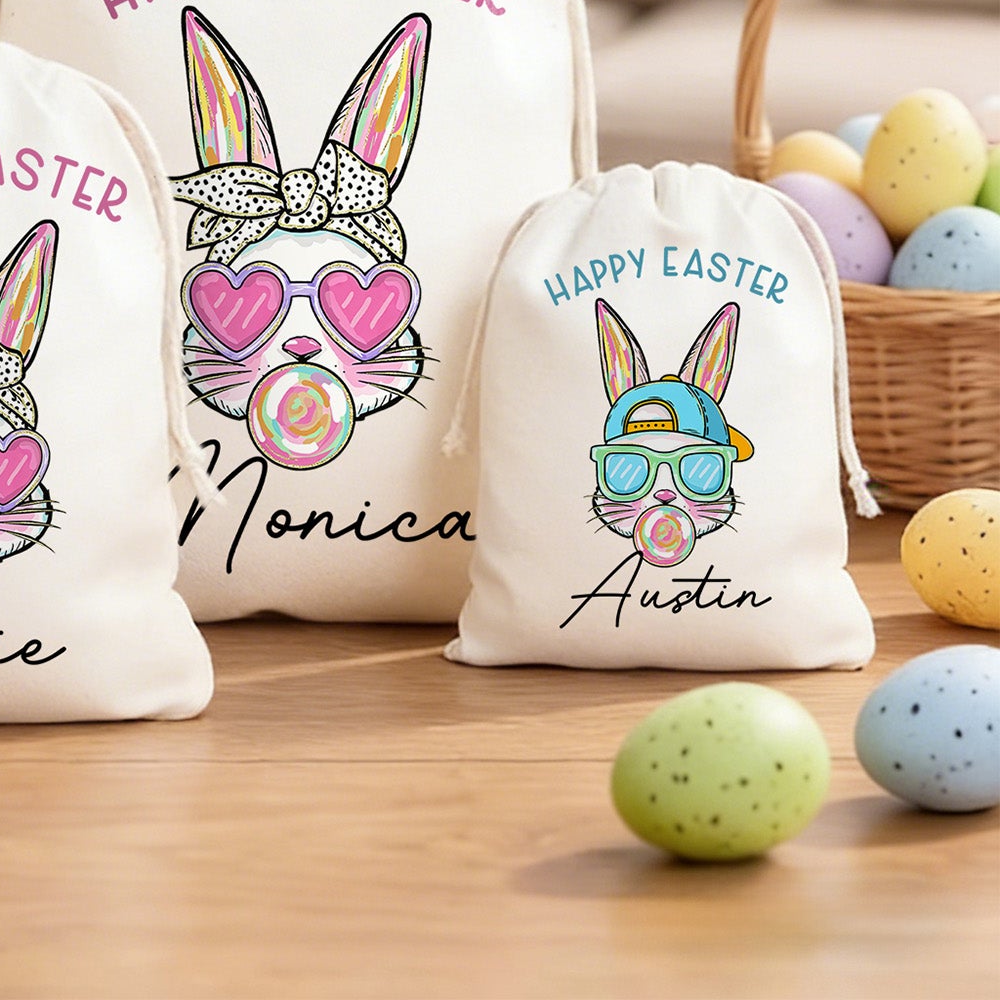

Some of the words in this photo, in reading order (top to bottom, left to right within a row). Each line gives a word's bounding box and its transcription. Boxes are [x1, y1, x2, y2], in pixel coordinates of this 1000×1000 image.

[543, 247, 645, 306] HAPPY
[663, 246, 789, 304] EASTER
[167, 439, 477, 575] Monica
[559, 550, 772, 629] Austin
